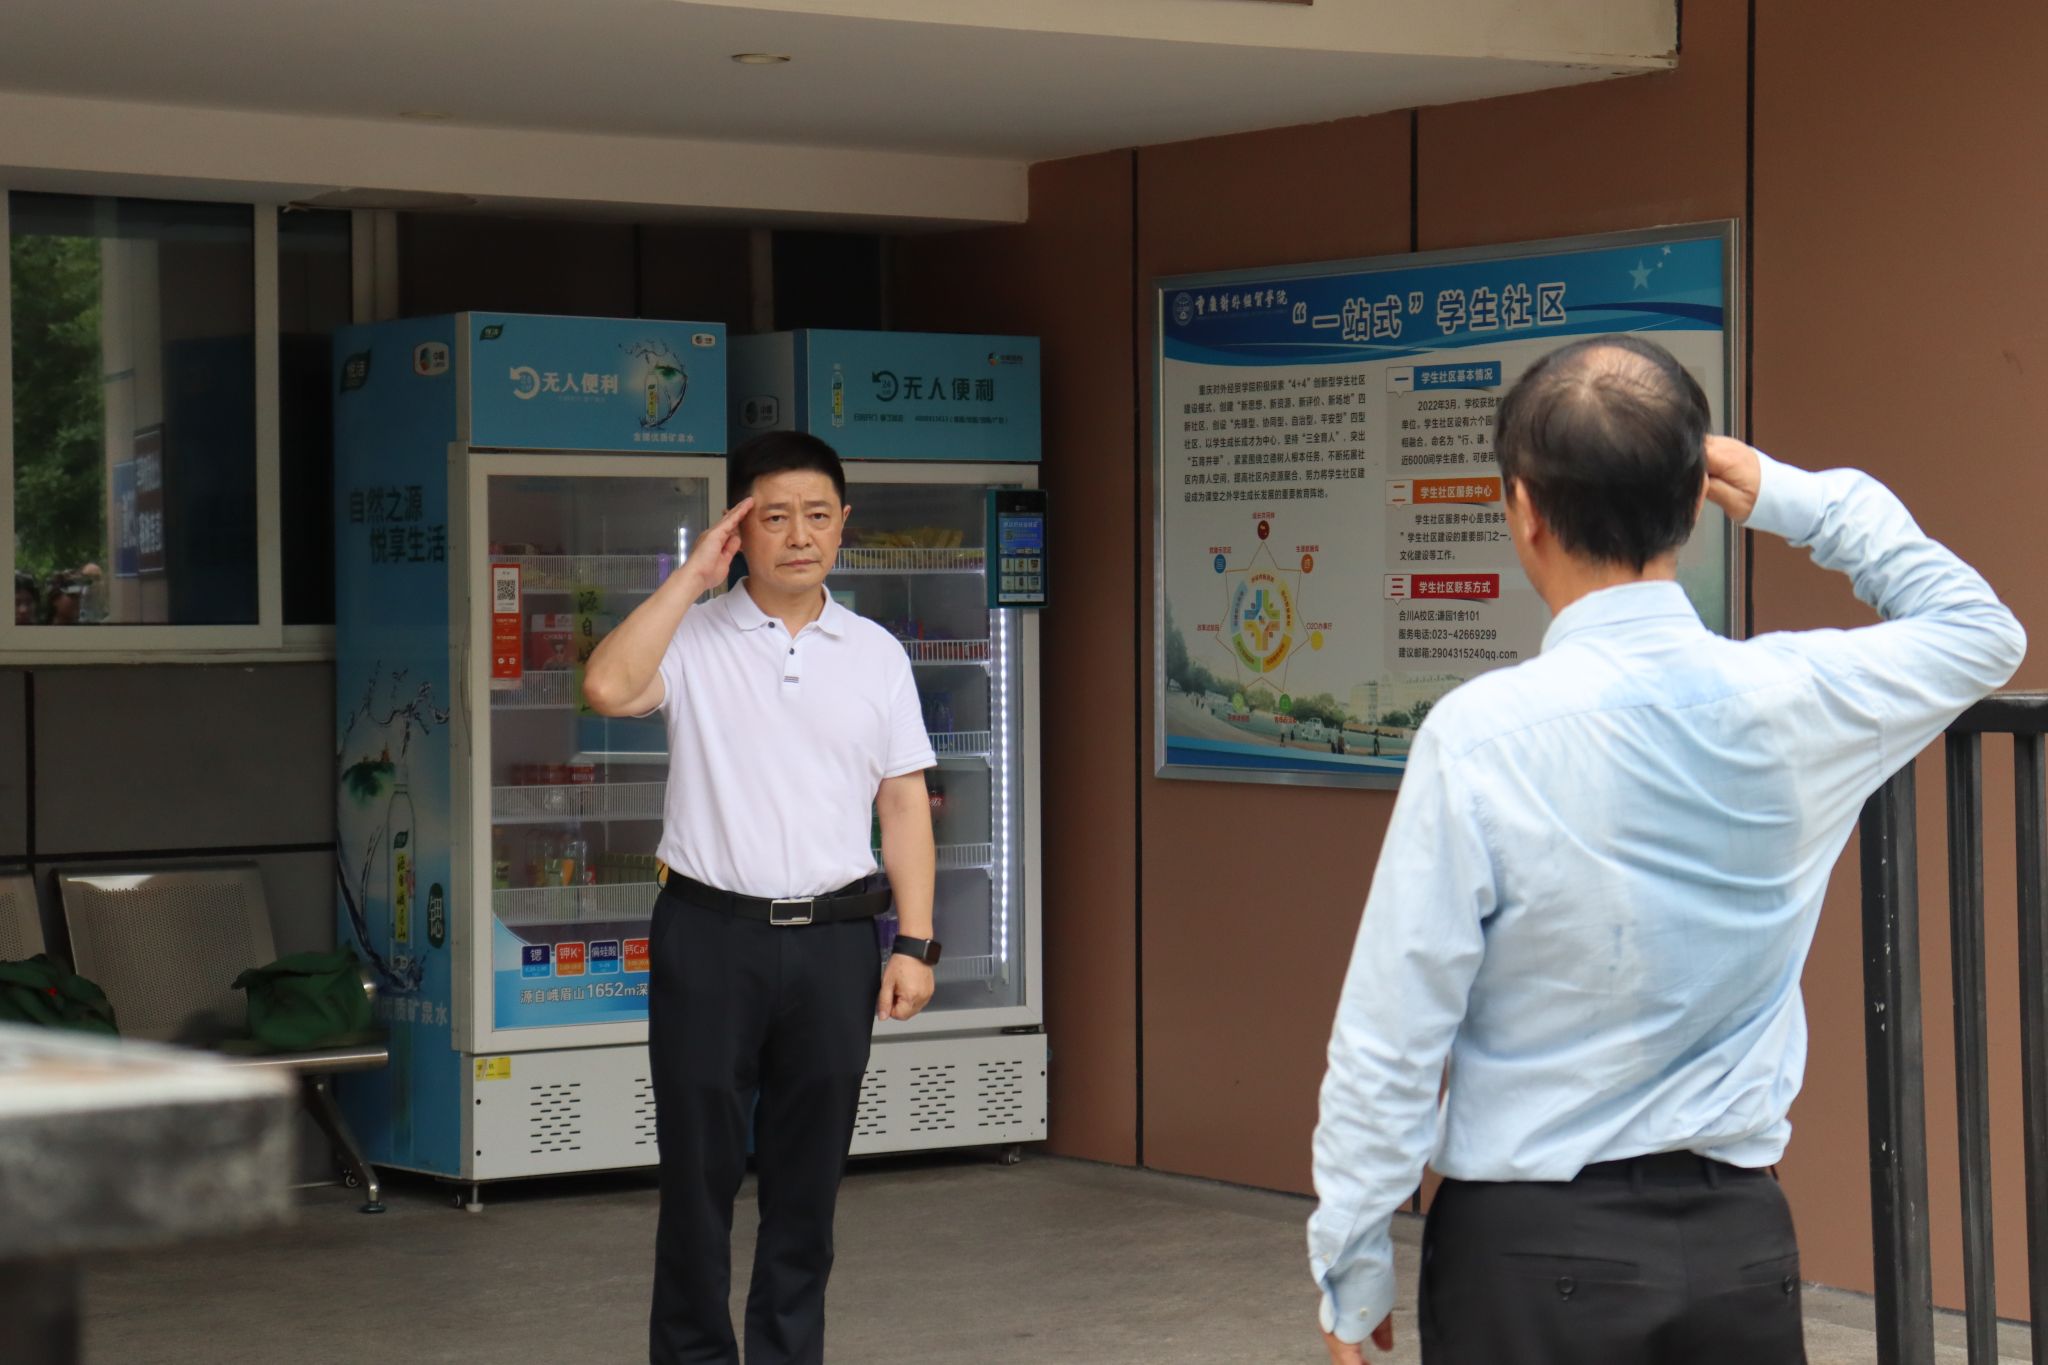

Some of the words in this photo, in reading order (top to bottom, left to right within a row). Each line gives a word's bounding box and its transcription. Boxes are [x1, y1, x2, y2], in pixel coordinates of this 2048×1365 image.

[542, 371, 618, 395] 无人便利
[1421, 367, 1494, 384] 学生社区基本情况
[903, 376, 995, 402] 无人便利
[351, 484, 424, 524] 自然之源
[1420, 485, 1493, 499] 学生社区服务中心
[369, 524, 448, 565] 悦享生活
[1419, 581, 1491, 594] 学生社区联系方式
